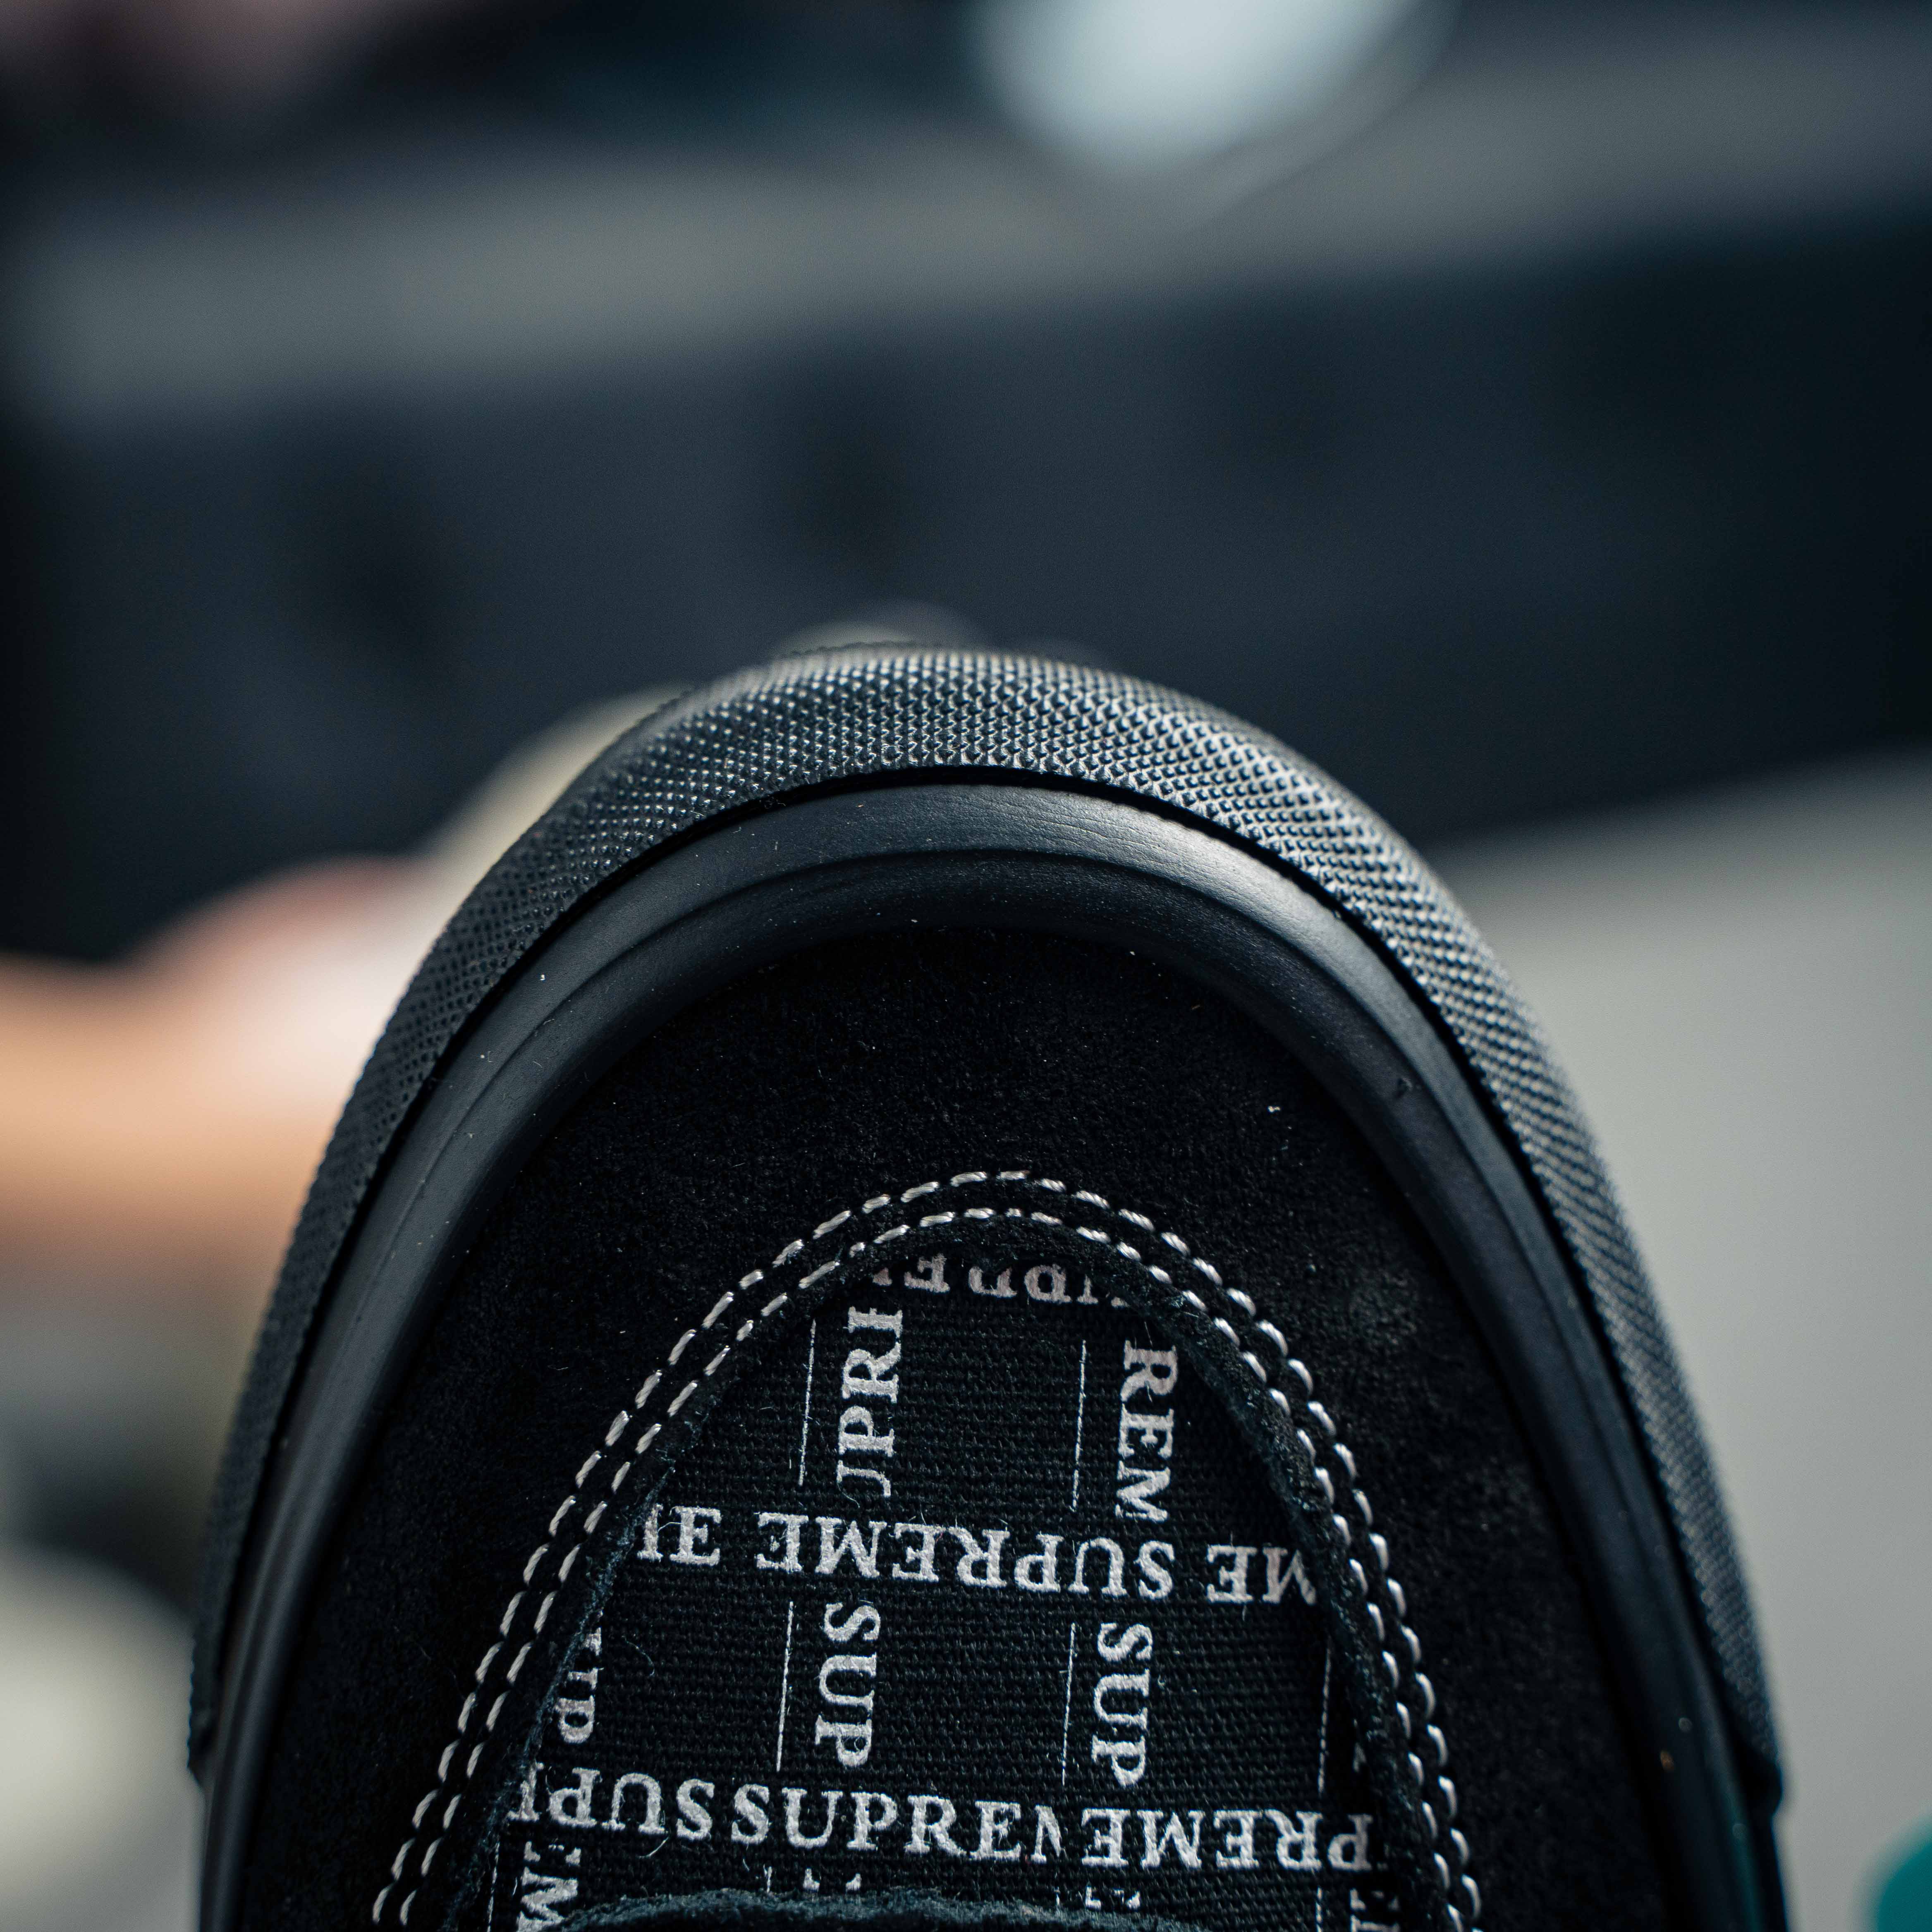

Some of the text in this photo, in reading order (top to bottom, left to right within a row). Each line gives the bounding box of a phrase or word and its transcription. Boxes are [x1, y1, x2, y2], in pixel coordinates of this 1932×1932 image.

[757, 1512, 1175, 1600] SUPREME
[815, 1602, 881, 1766] SUP
[1091, 1623, 1153, 1786] SUP
